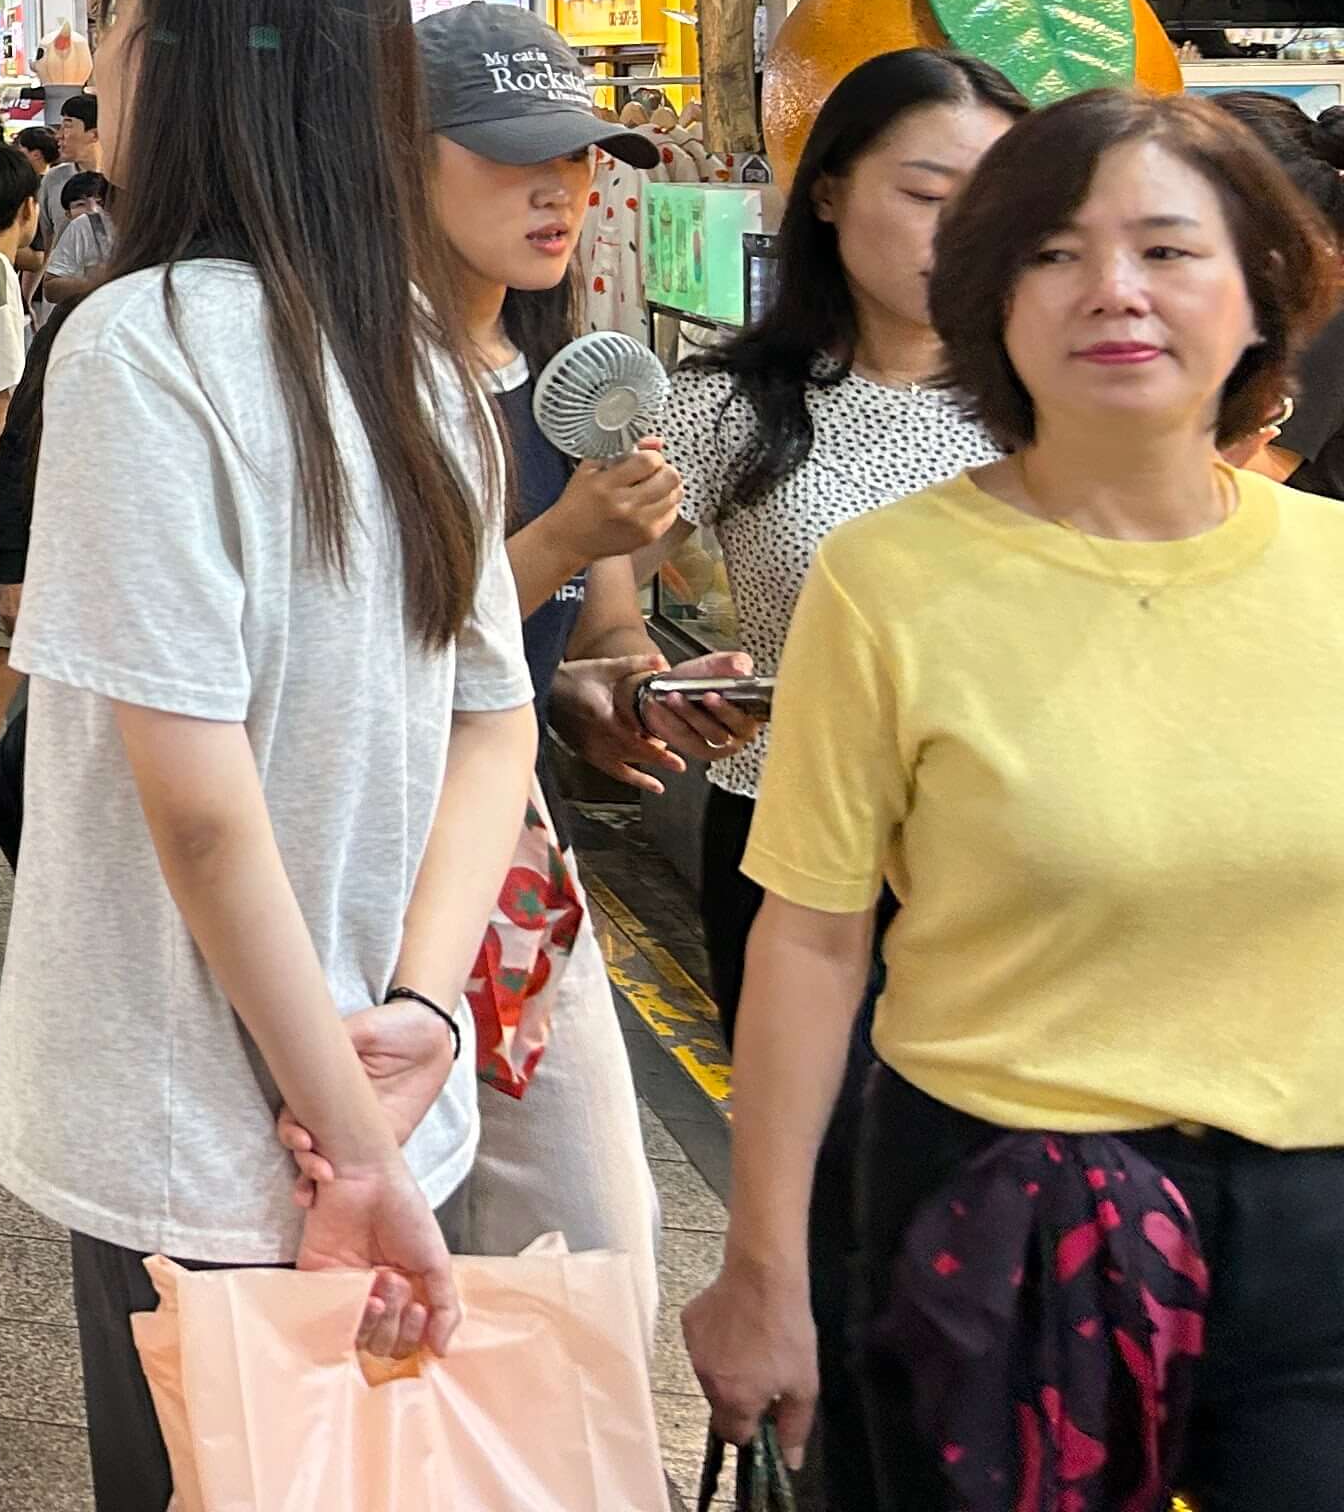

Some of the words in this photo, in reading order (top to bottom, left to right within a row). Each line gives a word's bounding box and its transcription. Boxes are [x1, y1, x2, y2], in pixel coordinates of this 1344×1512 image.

[482, 52, 509, 67] My
[512, 50, 536, 62] cat
[536, 48, 548, 62] is
